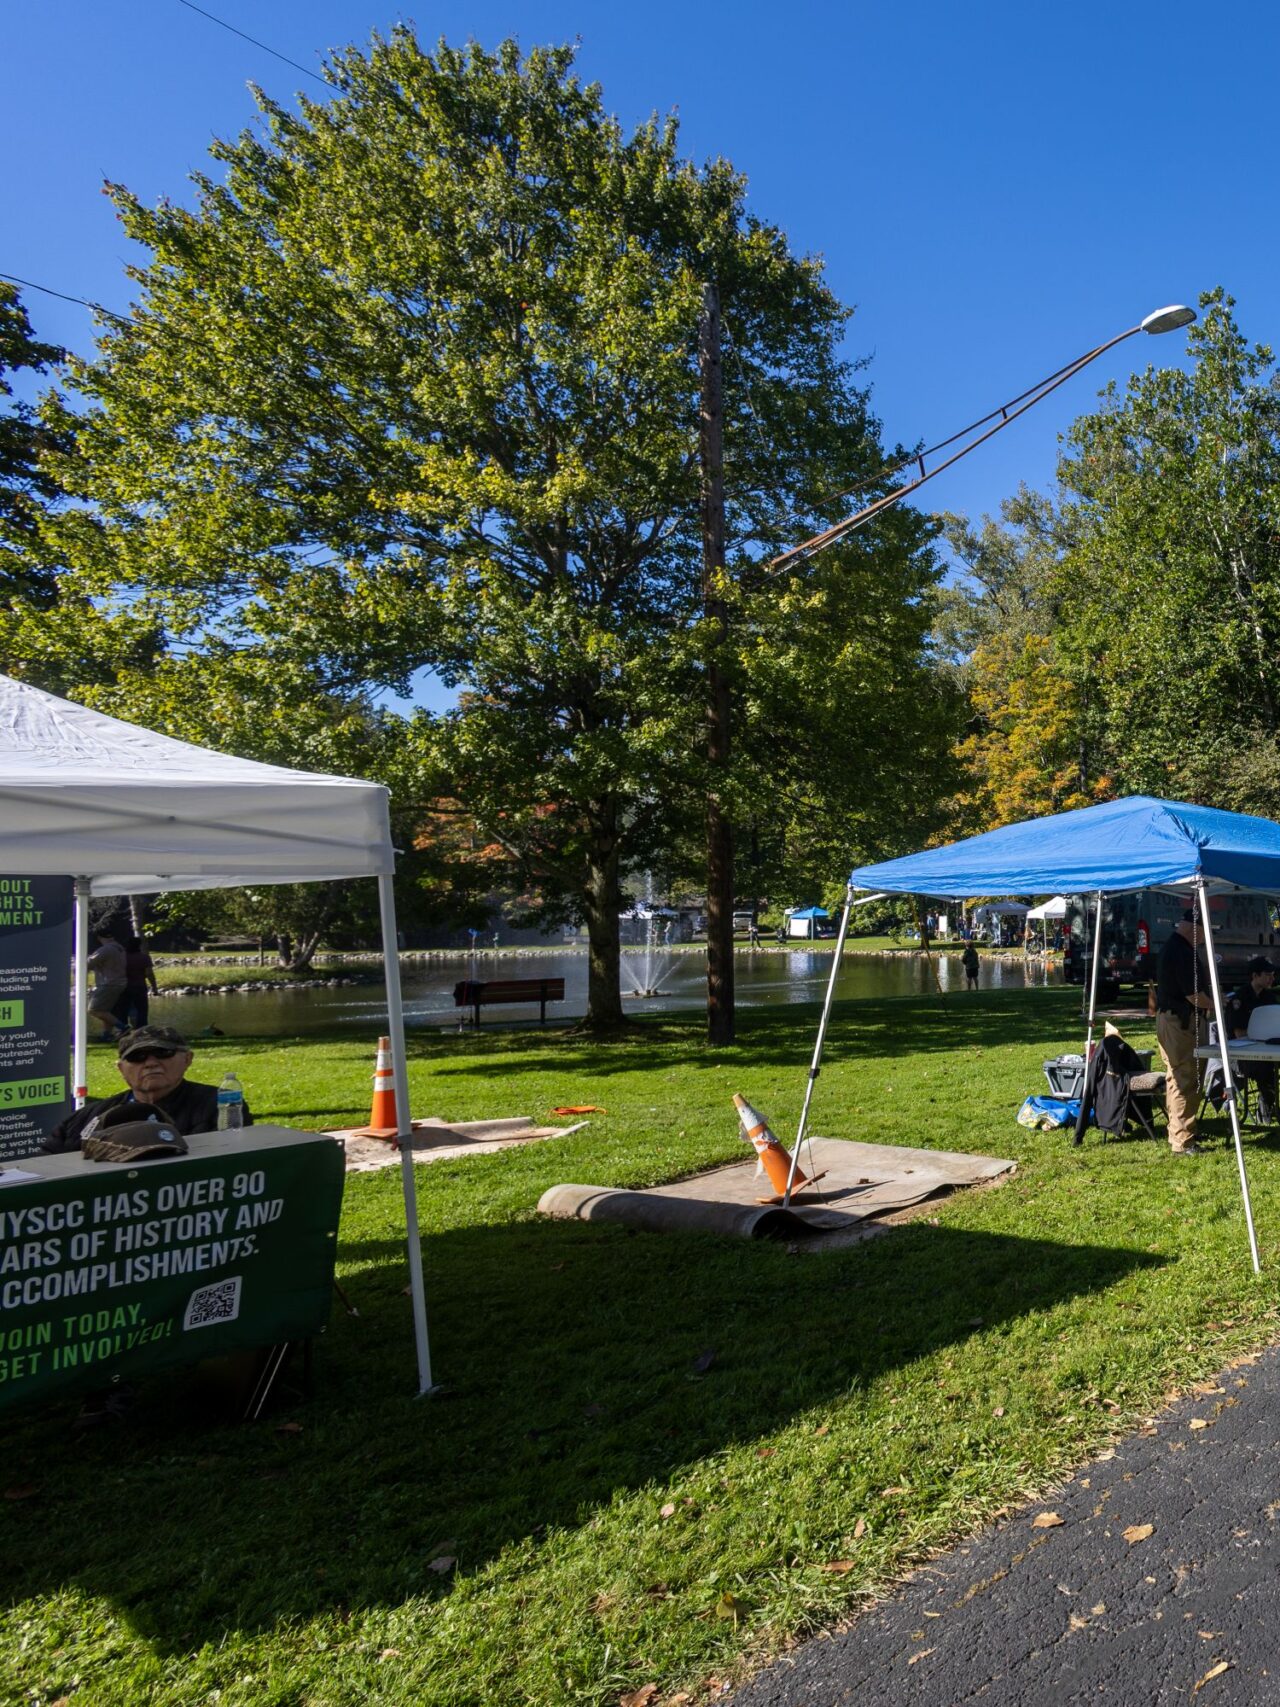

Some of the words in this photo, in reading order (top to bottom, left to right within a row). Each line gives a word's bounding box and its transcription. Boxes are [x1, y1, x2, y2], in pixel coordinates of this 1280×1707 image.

[0, 895, 35, 910] HTS
[0, 911, 44, 926] MENT
[0, 966, 48, 975] easonable
[9, 1031, 36, 1041] youth
[16, 1039, 50, 1048] county
[15, 1057, 34, 1065] and
[18, 1082, 60, 1100] VOICE
[1, 1113, 27, 1122] voice
[9, 1138, 34, 1147] work
[36, 1136, 47, 1144] to
[93, 1189, 149, 1224] HAS
[157, 1177, 225, 1212] OVER
[232, 1170, 265, 1199] 90
[71, 1230, 108, 1262] OF
[115, 1208, 228, 1253] HISTORY
[235, 1198, 284, 1231] AND
[0, 1234, 260, 1311] CCOMPLISHMENTS.
[64, 1303, 146, 1340] TODAY,
[53, 1318, 175, 1371] INVOLVED!
